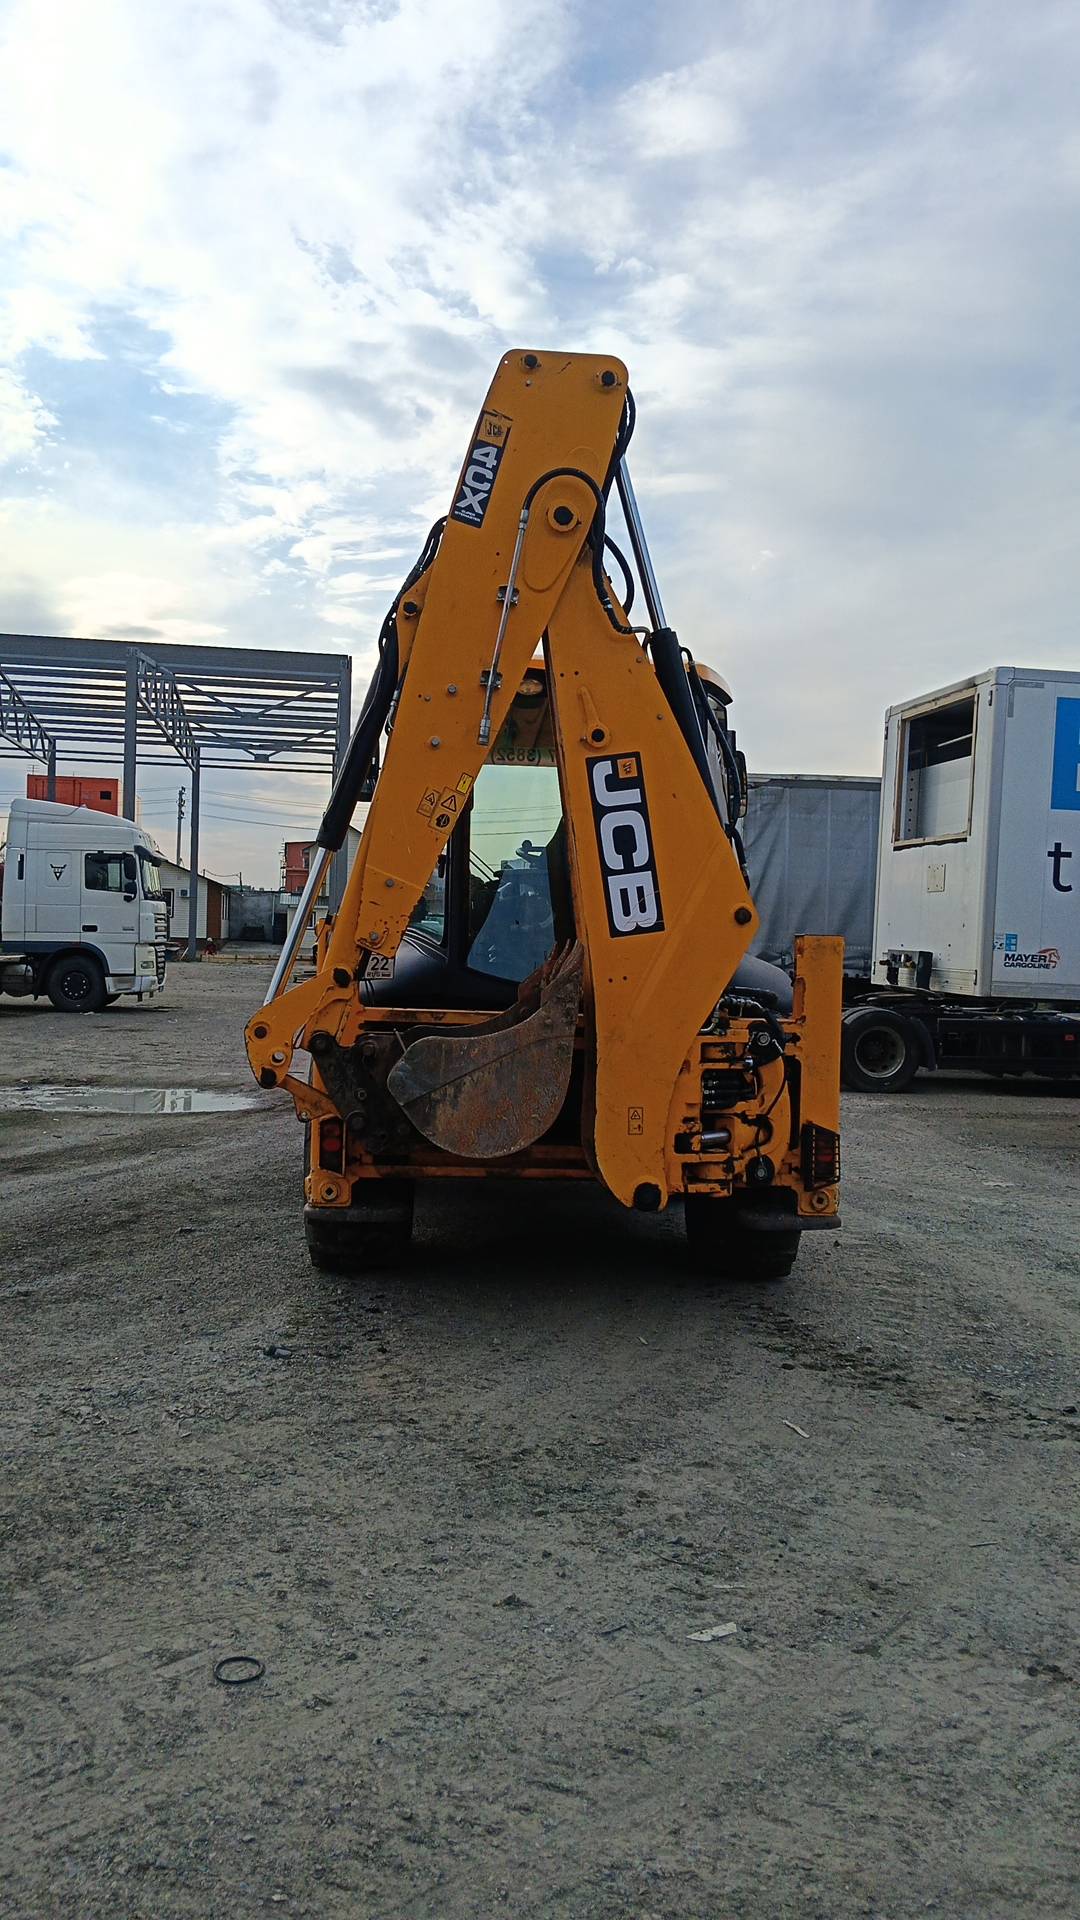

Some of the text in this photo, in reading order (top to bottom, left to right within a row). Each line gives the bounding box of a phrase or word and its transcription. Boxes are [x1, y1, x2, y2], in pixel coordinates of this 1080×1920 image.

[456, 446, 498, 515] 4CX
[592, 760, 658, 932] JCB
[1047, 842, 1073, 892] t
[371, 957, 389, 971] 22
[1003, 961, 1051, 969] CARGOLINE
[1004, 953, 1047, 963] MAYER
